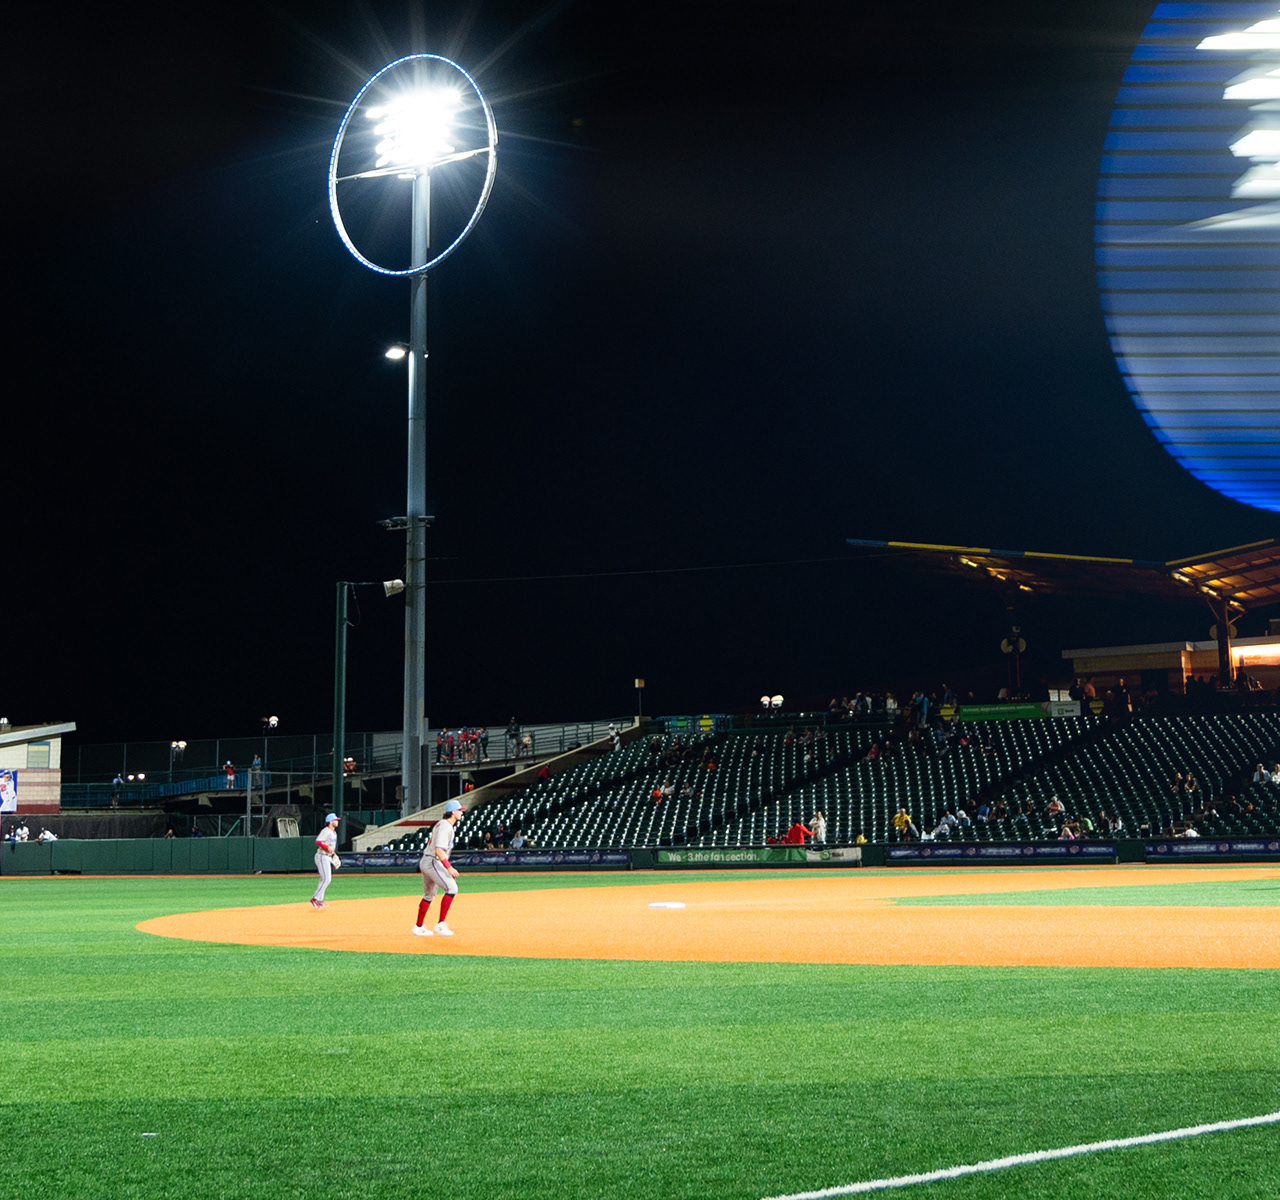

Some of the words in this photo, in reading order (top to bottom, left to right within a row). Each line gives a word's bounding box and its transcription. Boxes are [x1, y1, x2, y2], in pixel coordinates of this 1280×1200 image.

[668, 852, 681, 861] We
[695, 852, 709, 861] the
[710, 852, 724, 861] fan
[726, 851, 760, 861] section.
